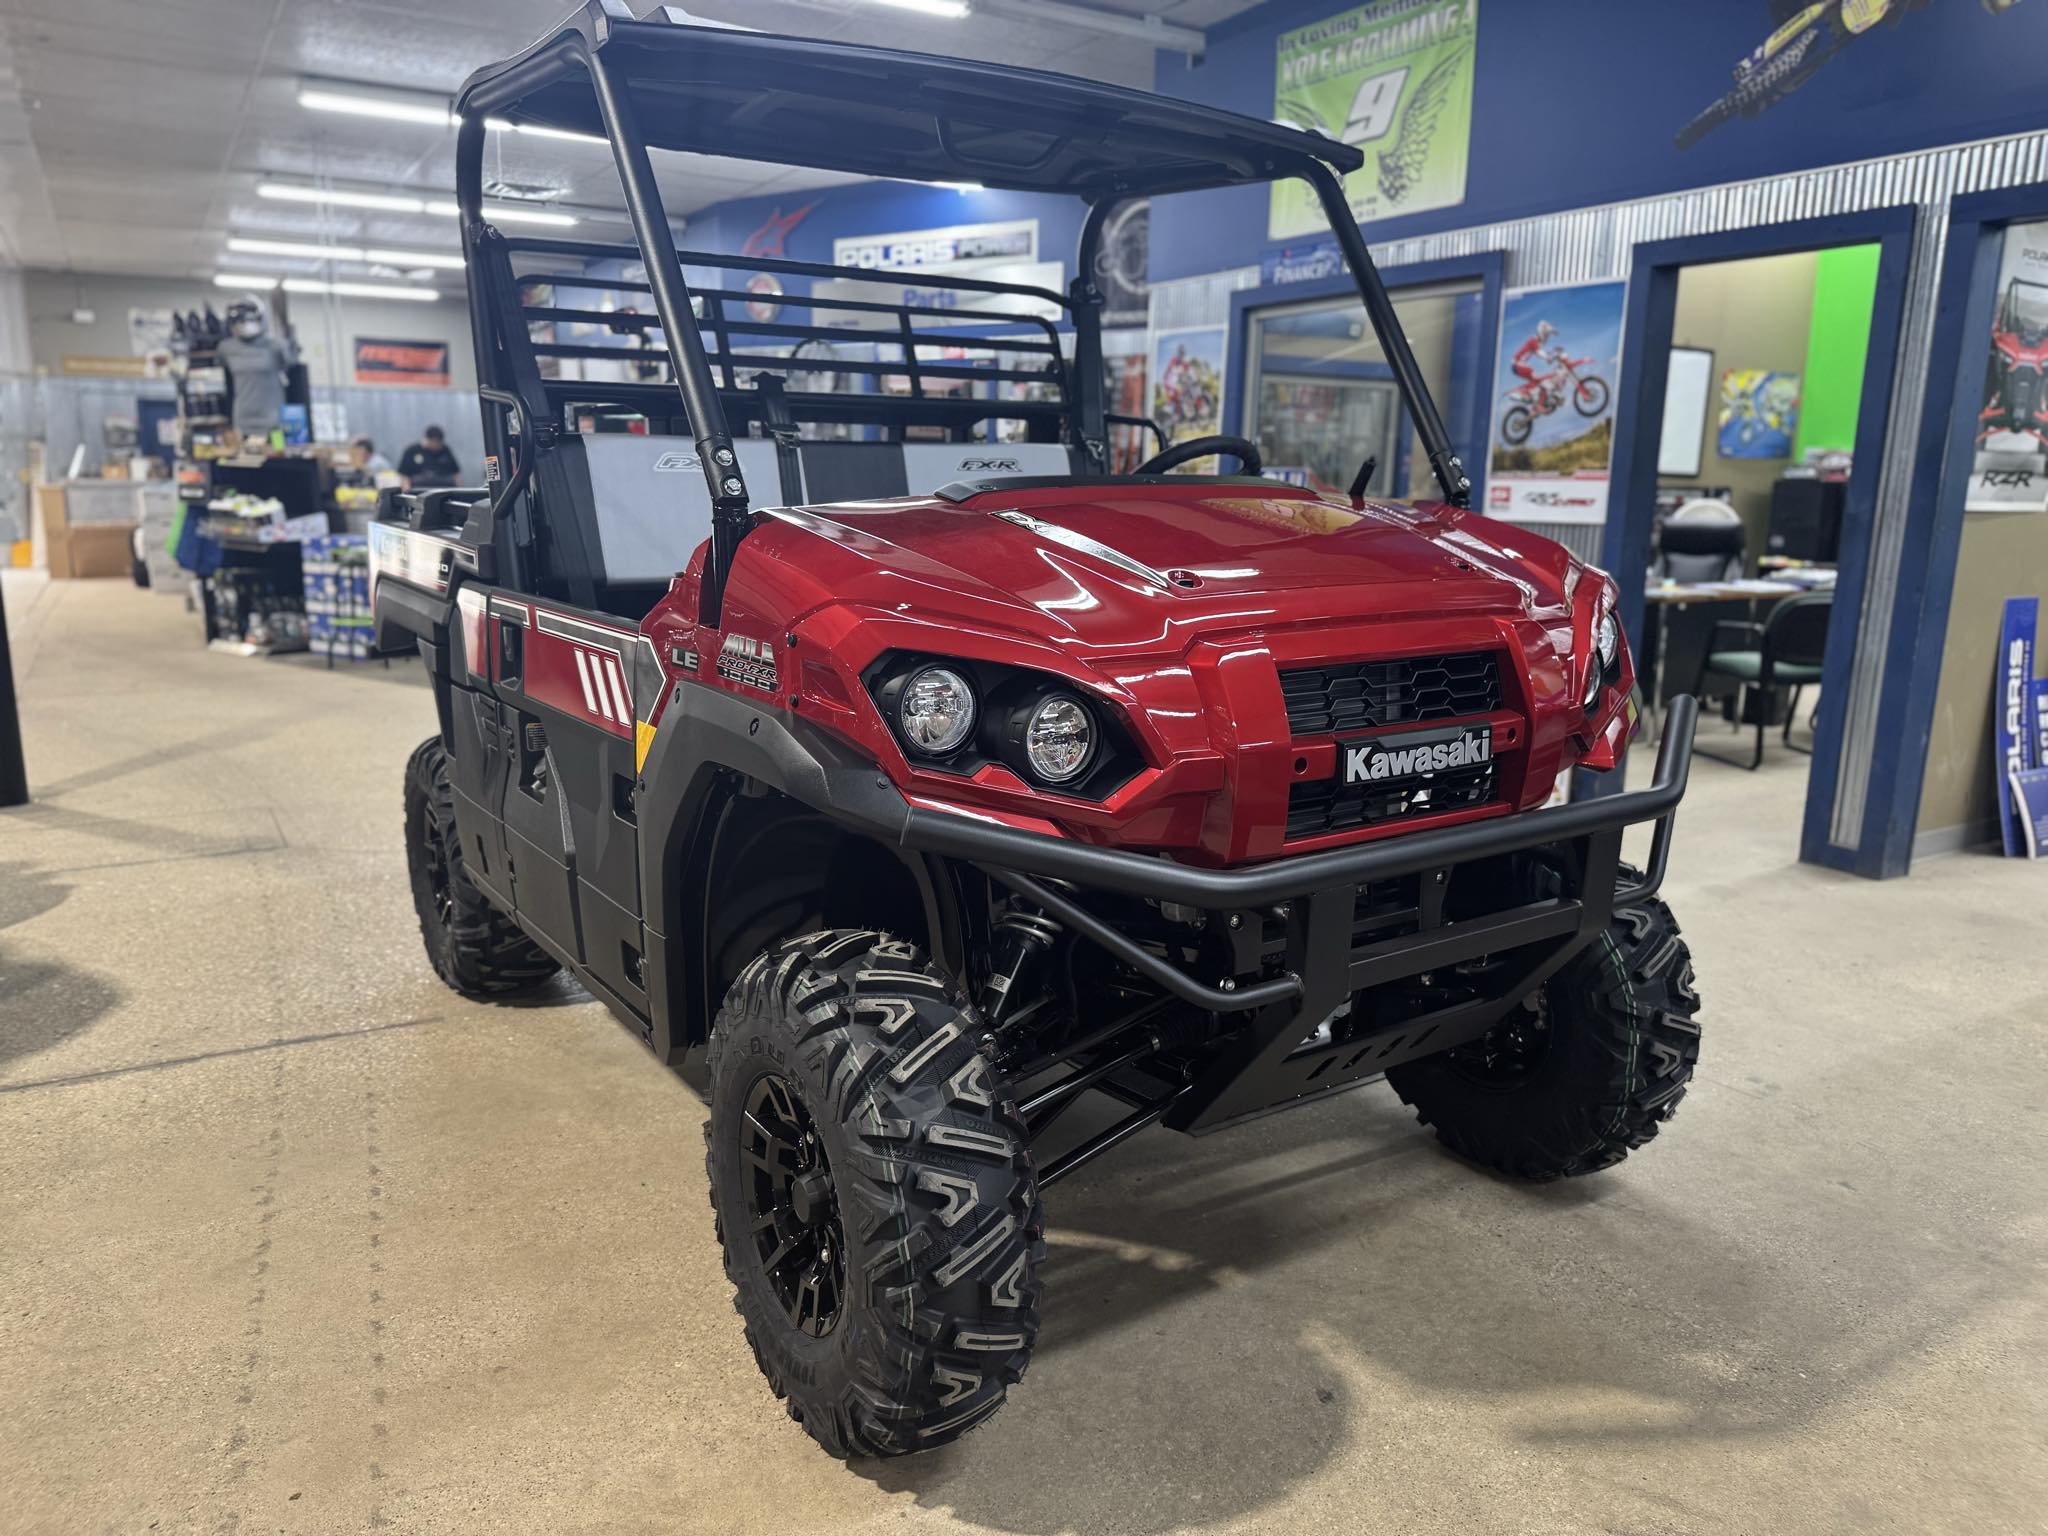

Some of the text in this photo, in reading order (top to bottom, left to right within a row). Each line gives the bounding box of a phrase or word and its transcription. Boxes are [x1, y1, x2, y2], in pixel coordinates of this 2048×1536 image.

[1300, 15, 1360, 45] Loving
[1341, 66, 1411, 143] 9
[842, 239, 955, 269] POLARIS
[903, 287, 957, 310] Parts
[657, 455, 702, 469] FX
[960, 459, 1018, 471] FXR
[1980, 469, 2034, 489] RZR
[671, 648, 698, 670] LE
[721, 632, 776, 668] MULE
[2007, 638, 2024, 782] OLARIS
[1346, 729, 1490, 783] Kawasaki
